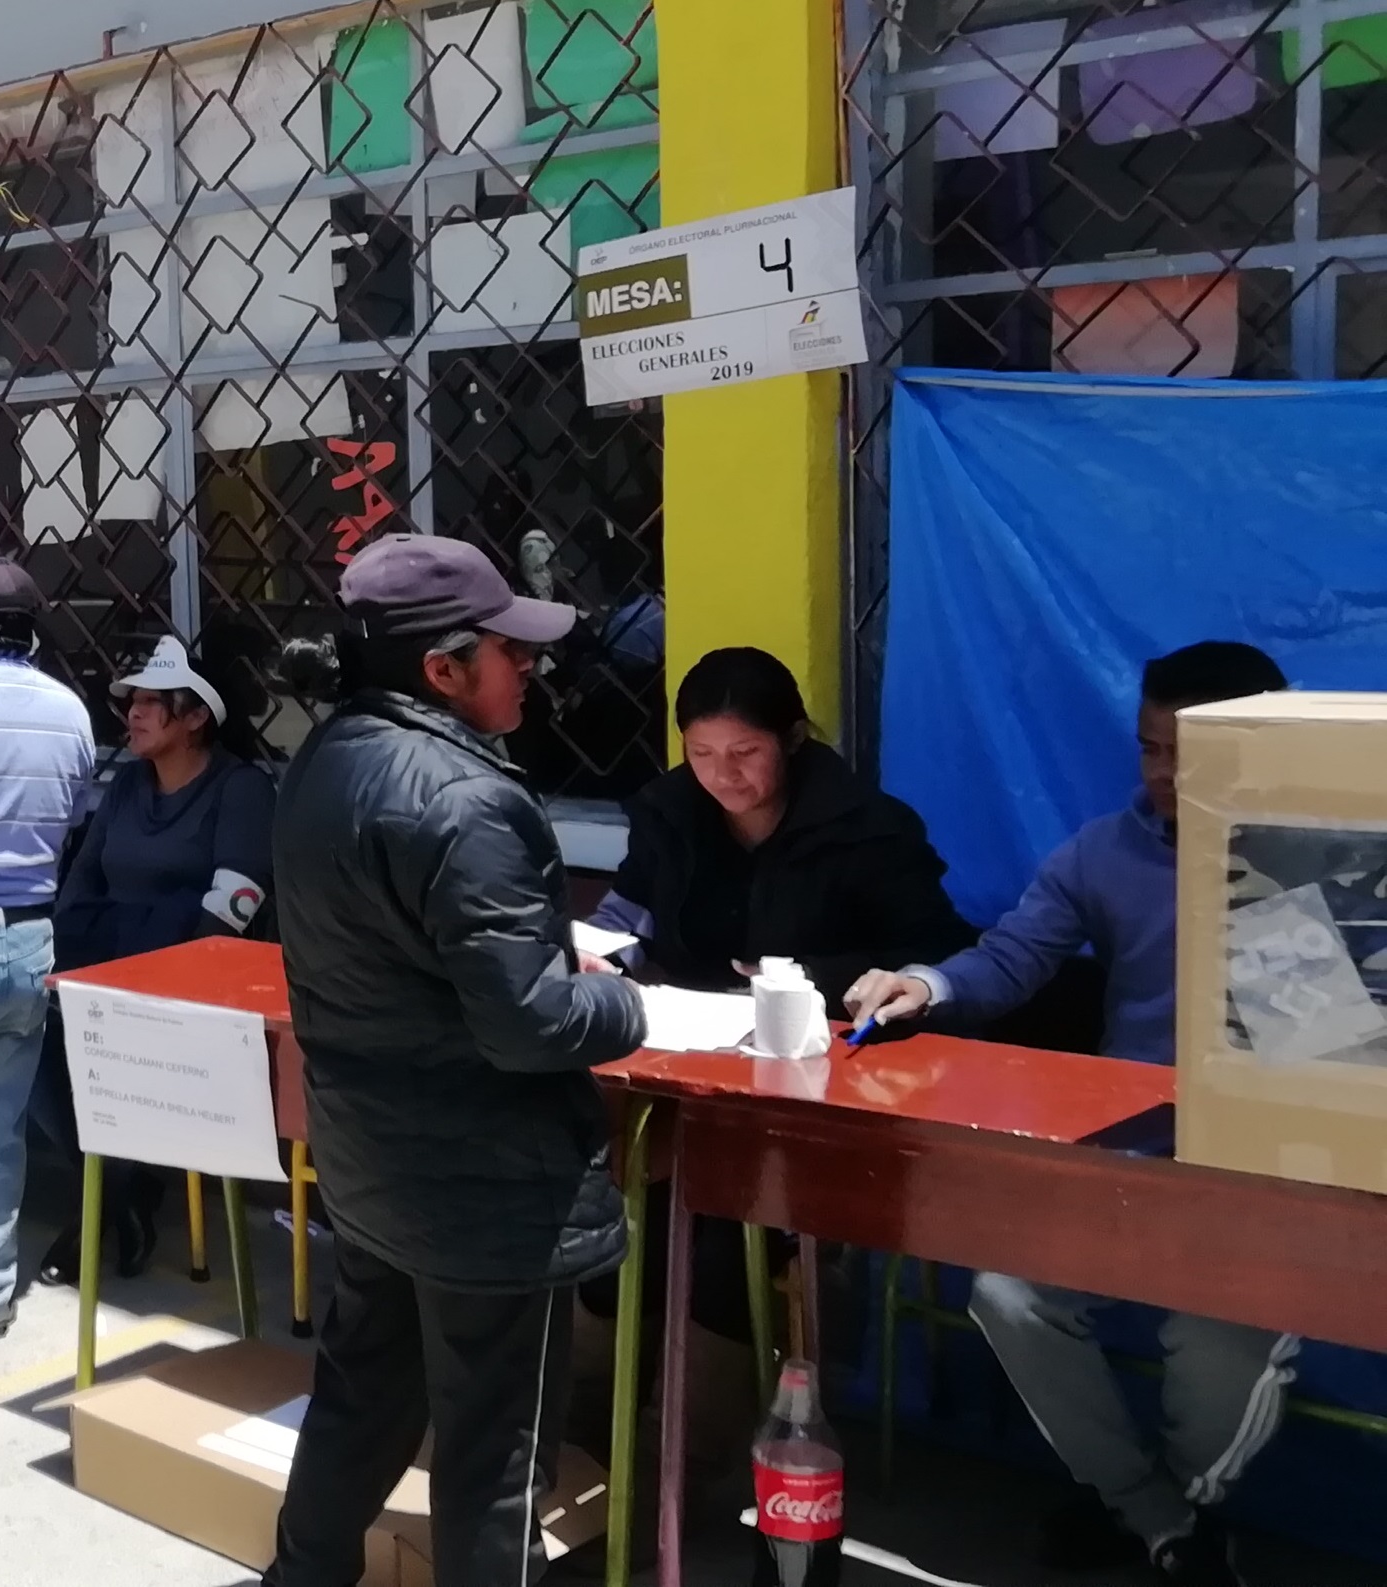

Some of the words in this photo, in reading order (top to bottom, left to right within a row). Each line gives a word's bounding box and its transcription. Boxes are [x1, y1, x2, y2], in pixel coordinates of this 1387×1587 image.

[668, 228, 722, 247] ELECTORAL
[724, 211, 798, 235] PLURINACIONAL
[758, 237, 795, 293] 4
[587, 276, 684, 319] MESA:
[591, 331, 685, 361] ELECCIONES
[638, 345, 729, 374] GENERALES
[711, 361, 754, 381] 2019
[83, 1030, 104, 1045] DE:
[242, 1033, 250, 1047] 4
[87, 1068, 101, 1081] A:
[165, 1062, 210, 1079] CEFERINO
